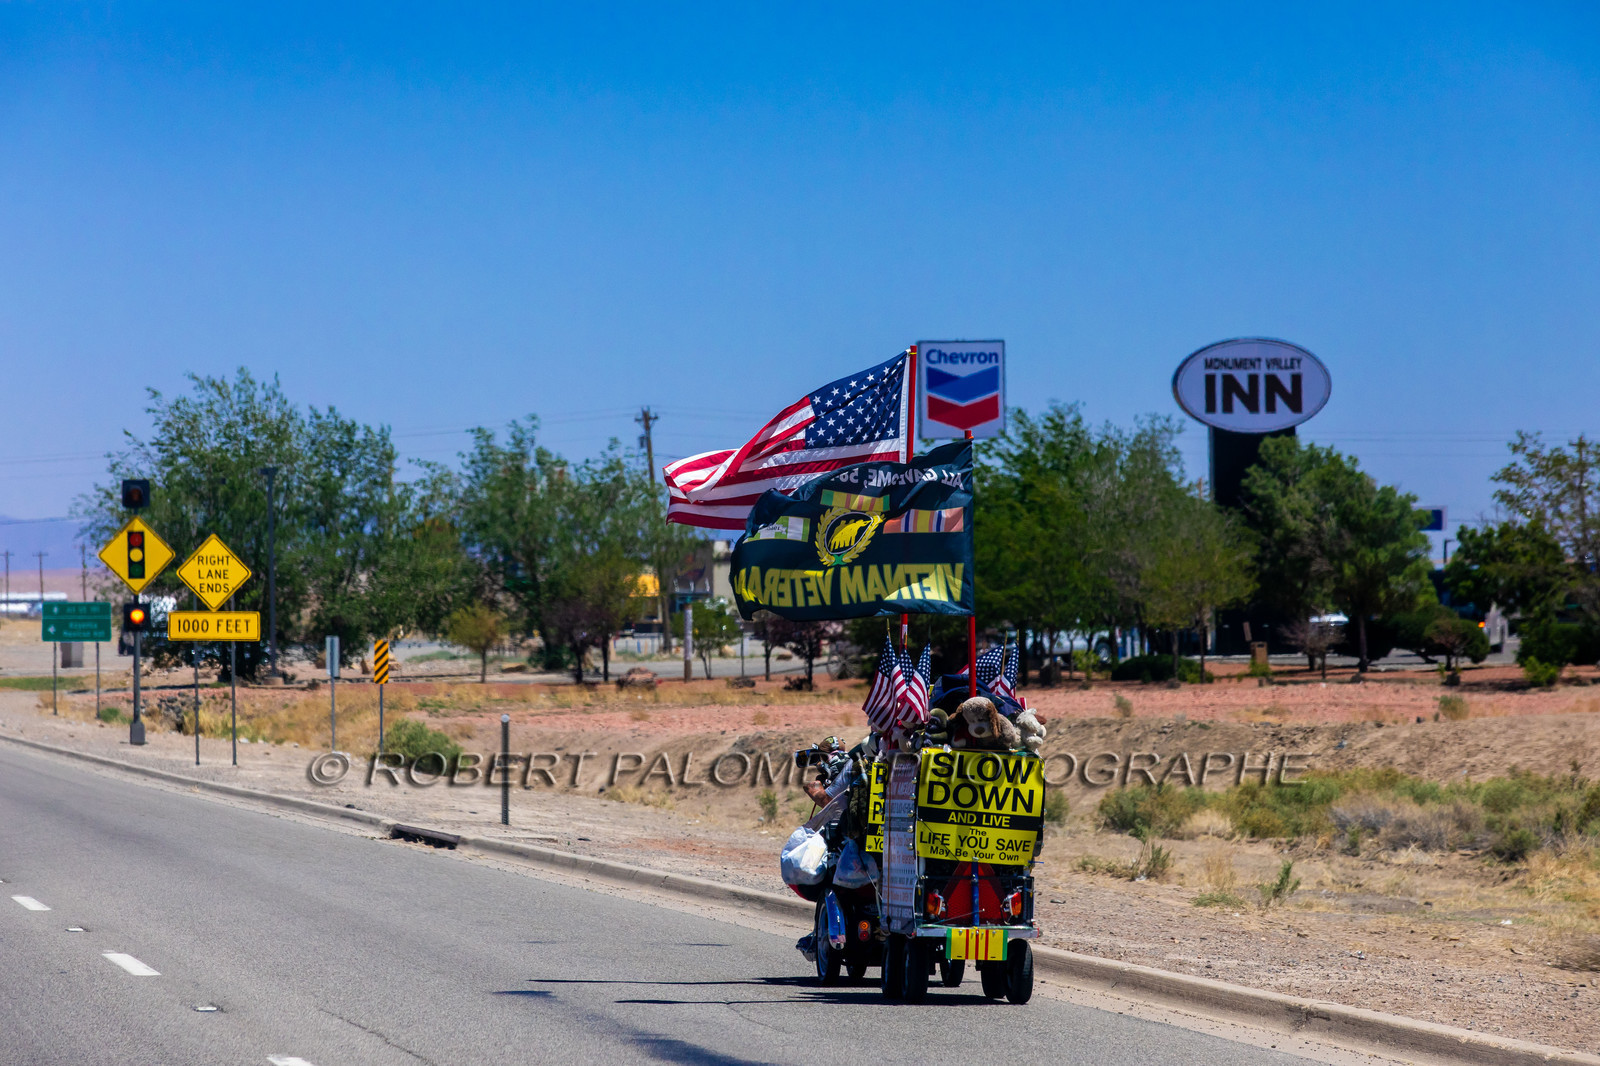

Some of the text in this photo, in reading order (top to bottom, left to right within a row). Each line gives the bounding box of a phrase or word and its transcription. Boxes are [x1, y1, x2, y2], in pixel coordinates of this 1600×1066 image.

[926, 348, 999, 365] Chevron
[1204, 357, 1303, 371] MONUMENT VALLEY
[1204, 373, 1303, 414] INN
[197, 555, 231, 566] RIGHT
[198, 569, 230, 580] LANE
[199, 583, 230, 593] ENDS
[178, 619, 251, 633] 1000 FEET
[931, 752, 1035, 784] SLOW
[926, 781, 1035, 813] DOWN
[948, 812, 1011, 828] AND LIVE
[970, 828, 987, 837] The
[919, 831, 1032, 853] LIFE YOU SAVE
[930, 846, 1020, 861] May Be Your Own
